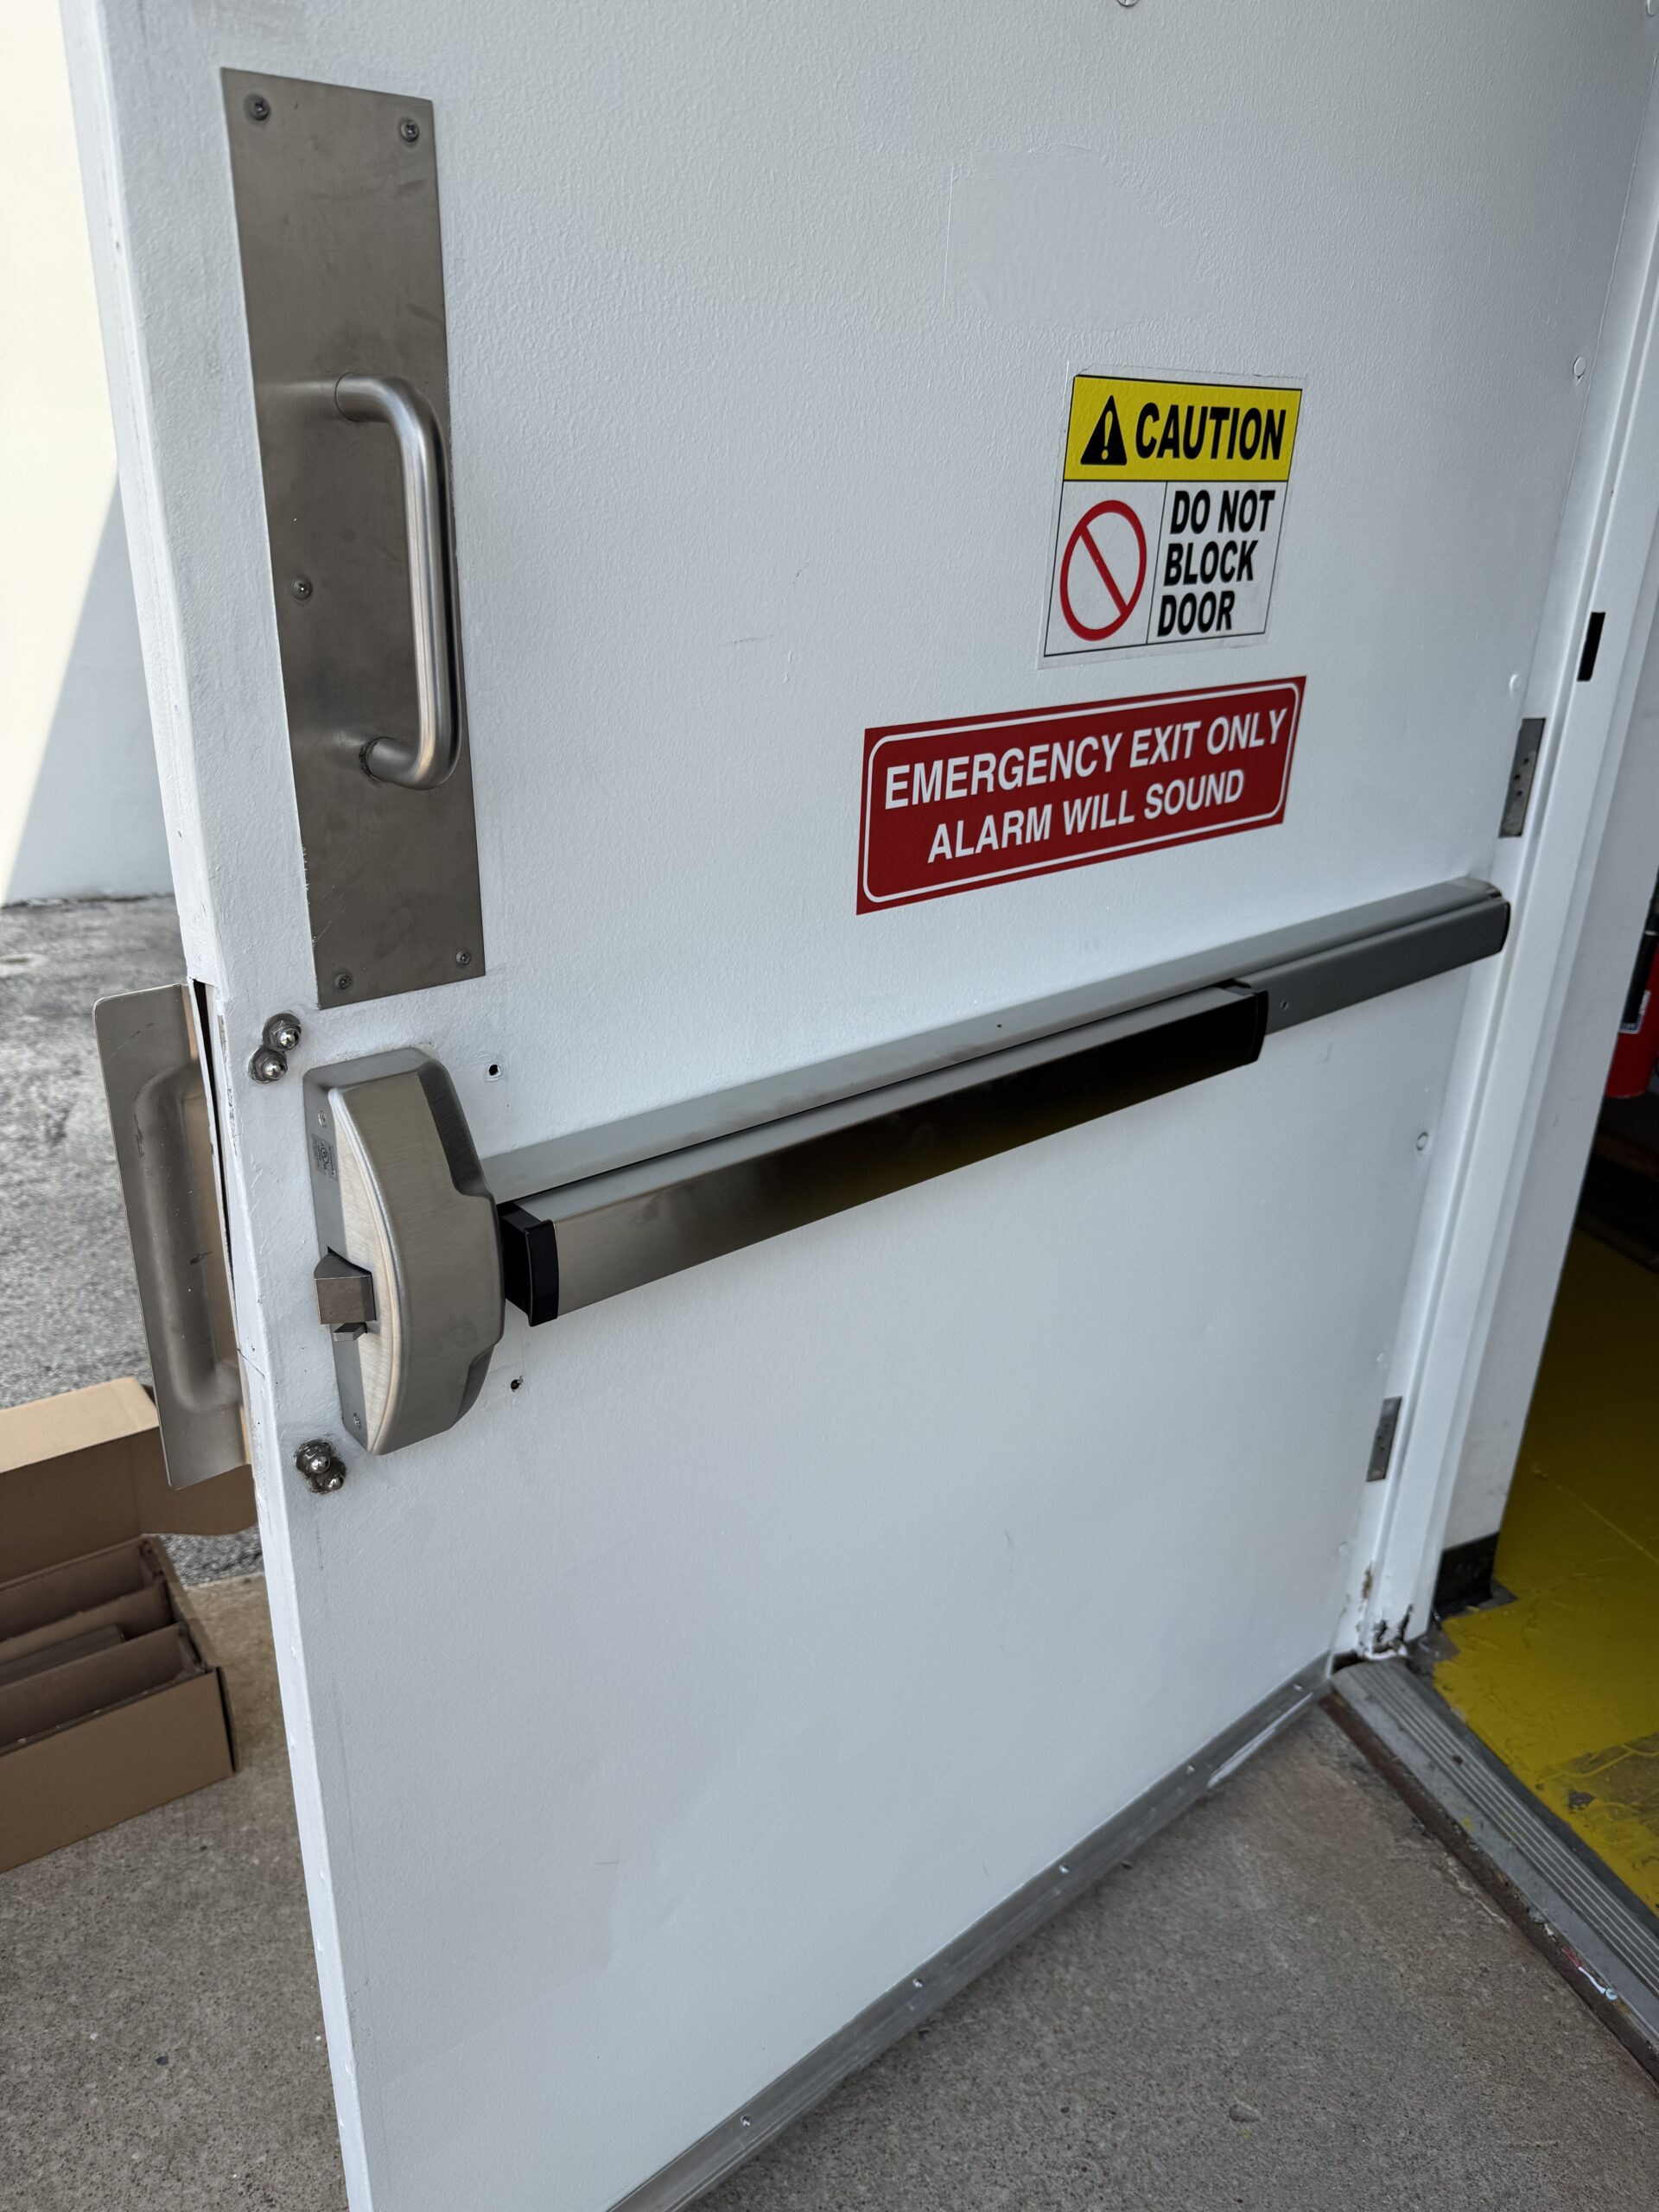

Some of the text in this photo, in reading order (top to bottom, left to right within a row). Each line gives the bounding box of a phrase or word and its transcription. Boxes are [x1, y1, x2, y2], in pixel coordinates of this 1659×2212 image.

[1135, 402, 1287, 461] CAUTION
[1169, 489, 1276, 535] DO NOT
[1163, 539, 1258, 587] BLOCK
[1156, 590, 1236, 638] DOOR
[884, 707, 1288, 810] EMERGENCY EXIT ONLY
[926, 768, 1245, 864] ALARM WILL SOUND
